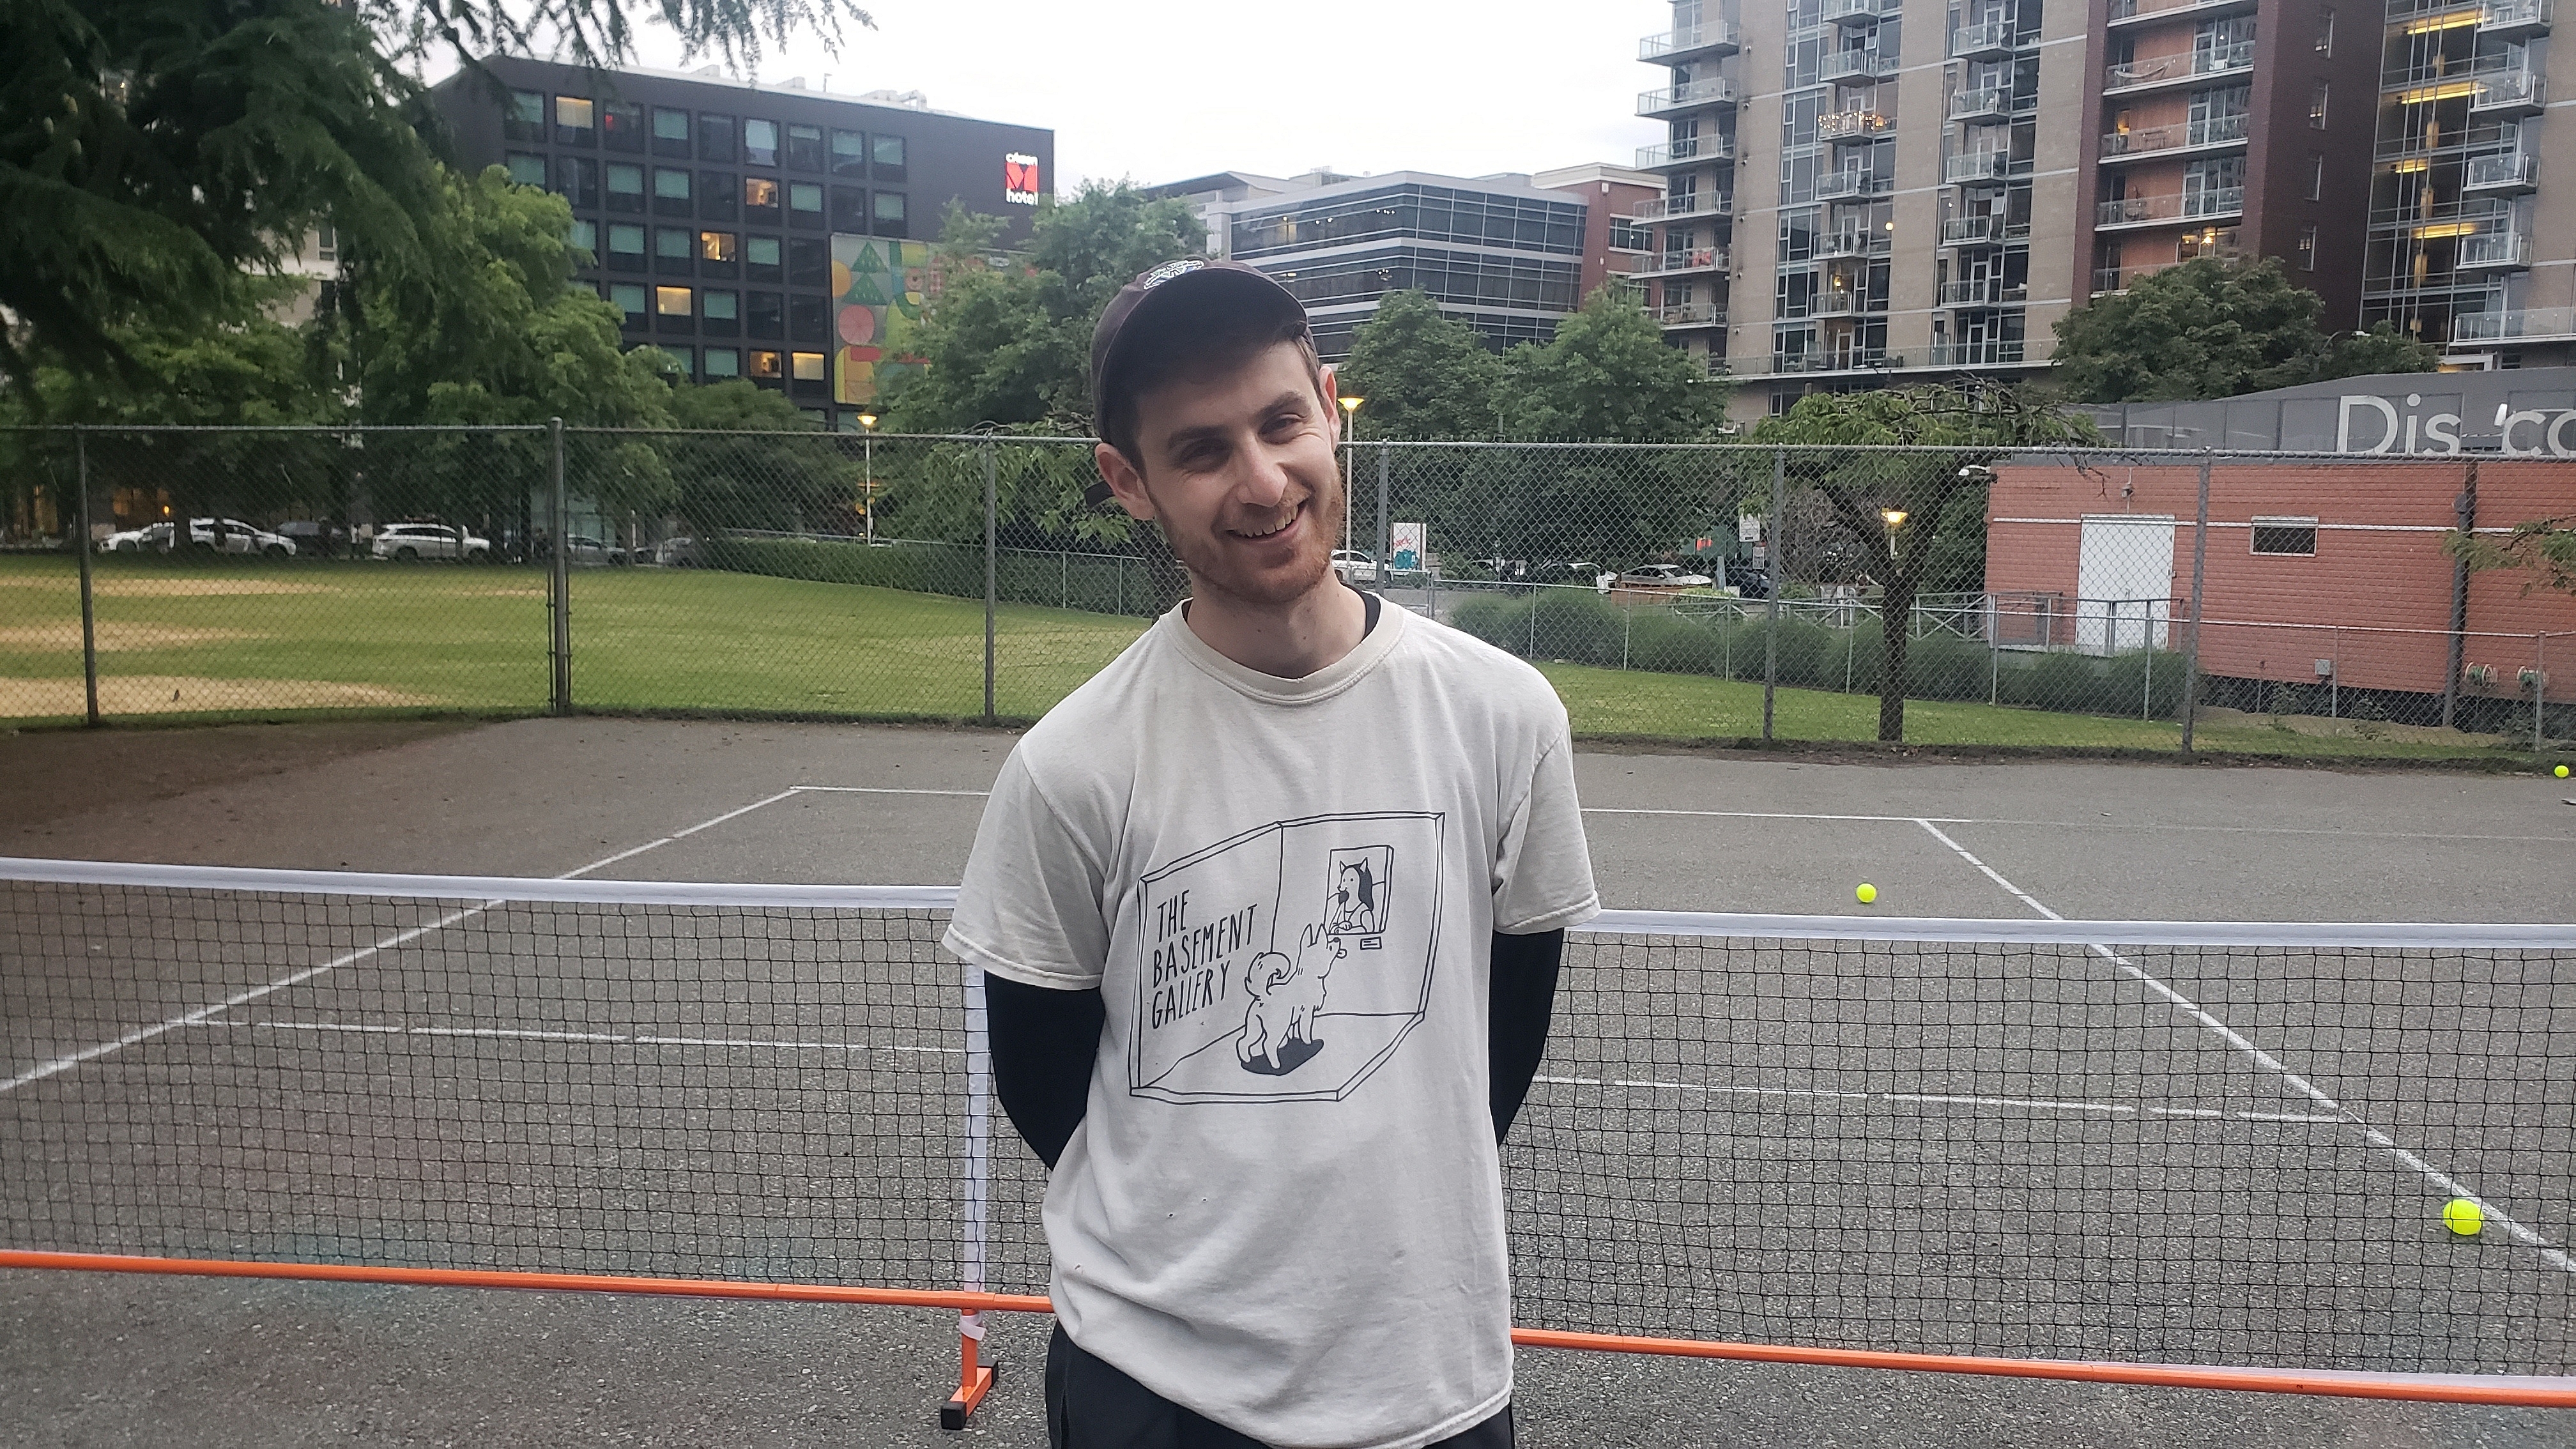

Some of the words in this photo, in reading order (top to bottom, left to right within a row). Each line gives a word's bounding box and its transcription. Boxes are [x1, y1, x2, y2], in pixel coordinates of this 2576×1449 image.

[1006, 188, 1039, 205] hotel
[1153, 903, 1258, 988] BASEMENT
[1157, 889, 1190, 942] THE
[1151, 960, 1231, 1029] GALLERY
